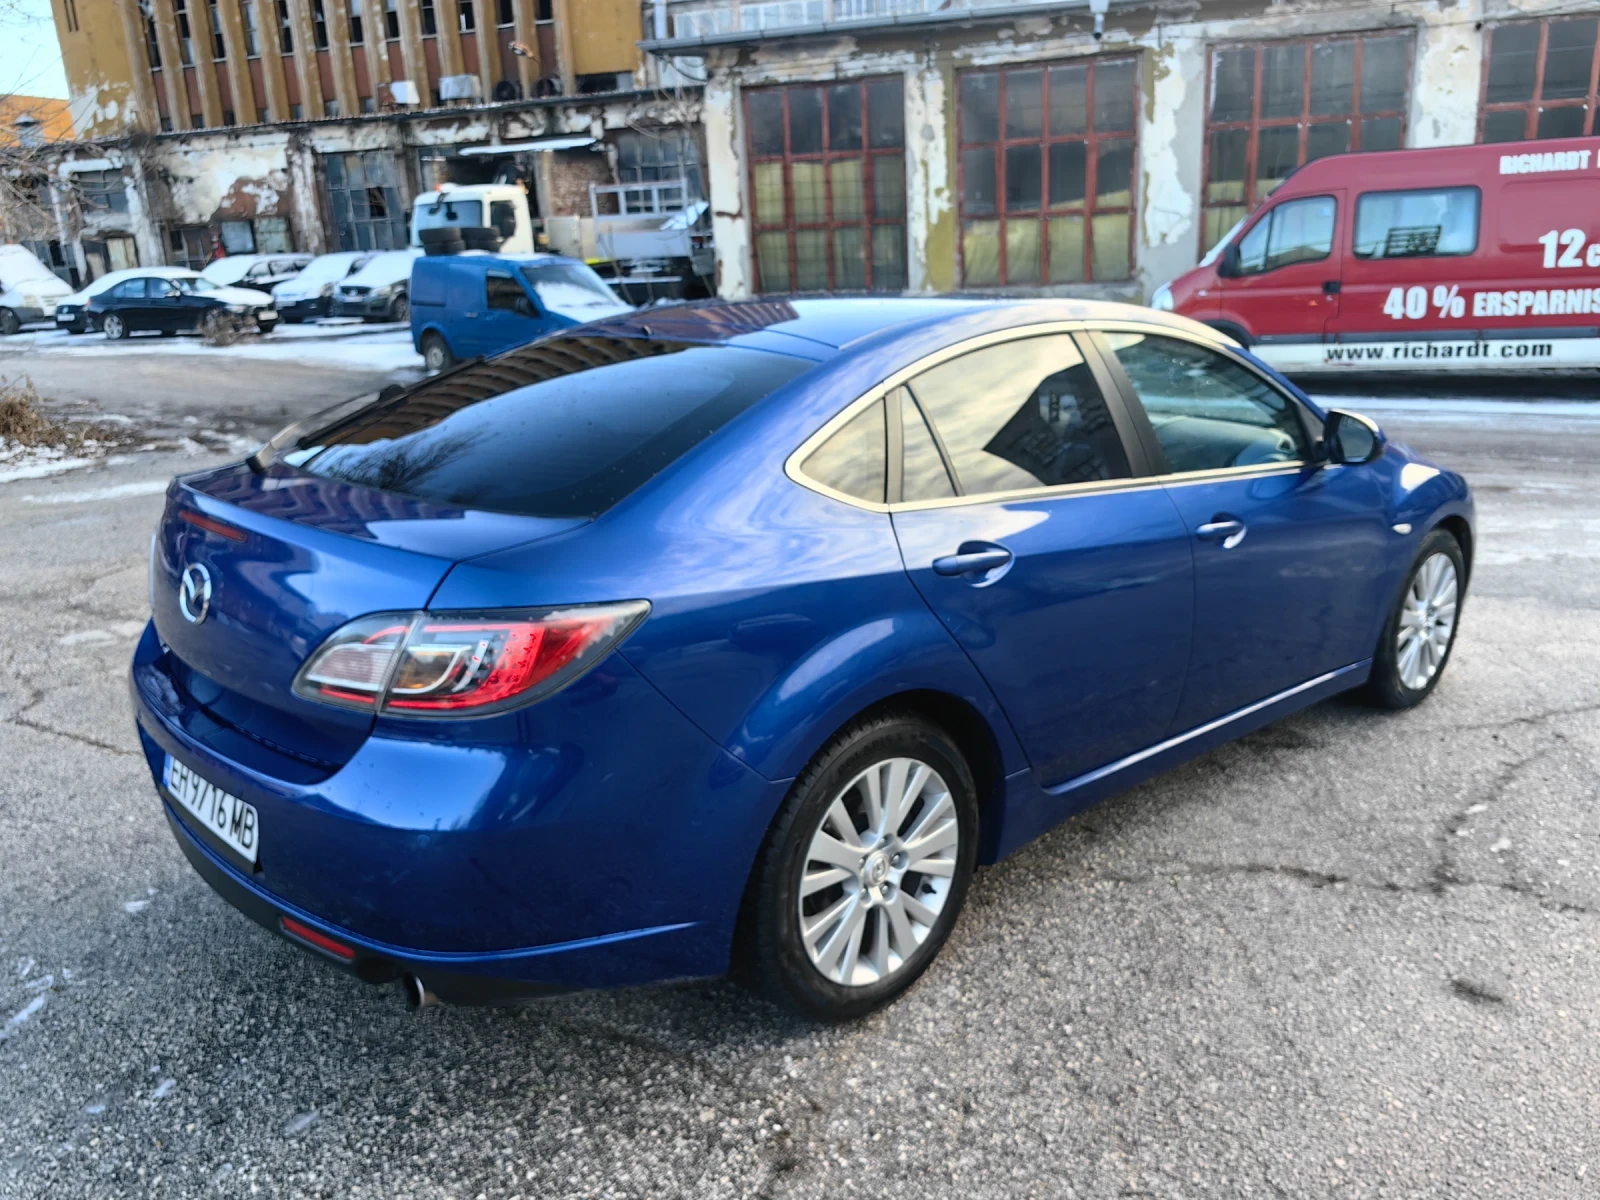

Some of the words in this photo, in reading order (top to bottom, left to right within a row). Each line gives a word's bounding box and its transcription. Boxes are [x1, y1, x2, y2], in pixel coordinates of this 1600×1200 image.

[1500, 150, 1591, 174] RICHARDT
[1383, 286, 1427, 319] 40
[1433, 284, 1465, 318] %
[1327, 341, 1553, 359] www.richardt.com
